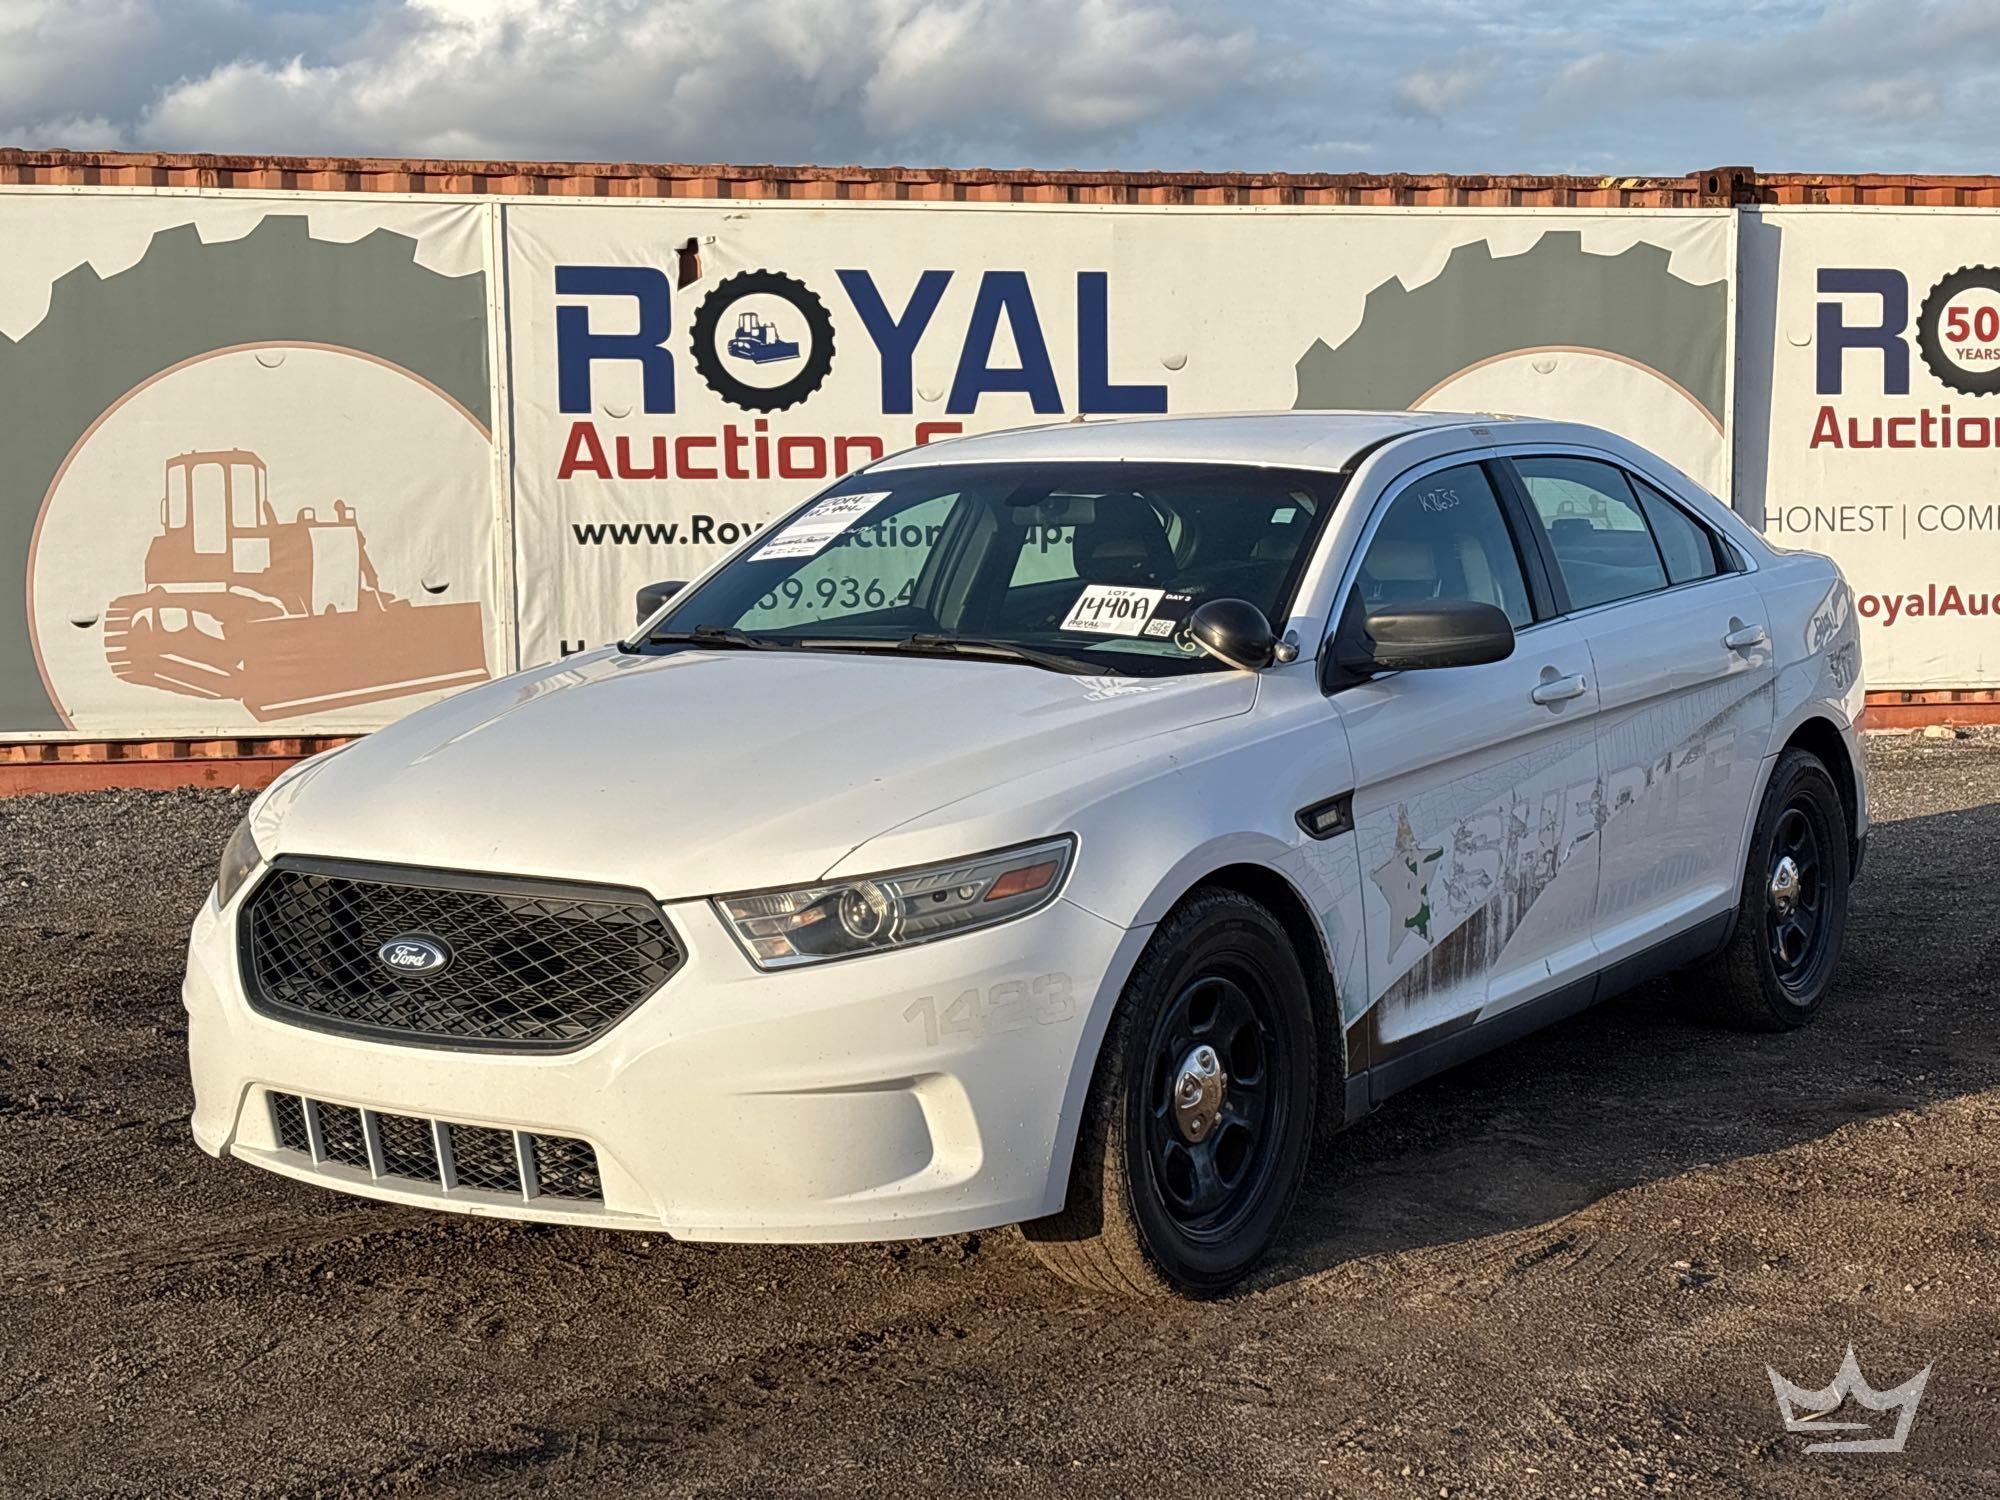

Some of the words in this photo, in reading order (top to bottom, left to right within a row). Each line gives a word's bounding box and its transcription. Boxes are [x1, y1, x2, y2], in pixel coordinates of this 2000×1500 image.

[555, 265, 1168, 414] ROYAL
[1945, 306, 2000, 342] 50
[1956, 348, 2000, 360] YEARS
[1809, 405, 2000, 449] Auctio
[557, 418, 884, 480] Auction
[1763, 505, 1893, 533] HONEST
[1917, 504, 2000, 531] COM
[1074, 597, 1149, 621] 1440A
[390, 945, 427, 966] Ford
